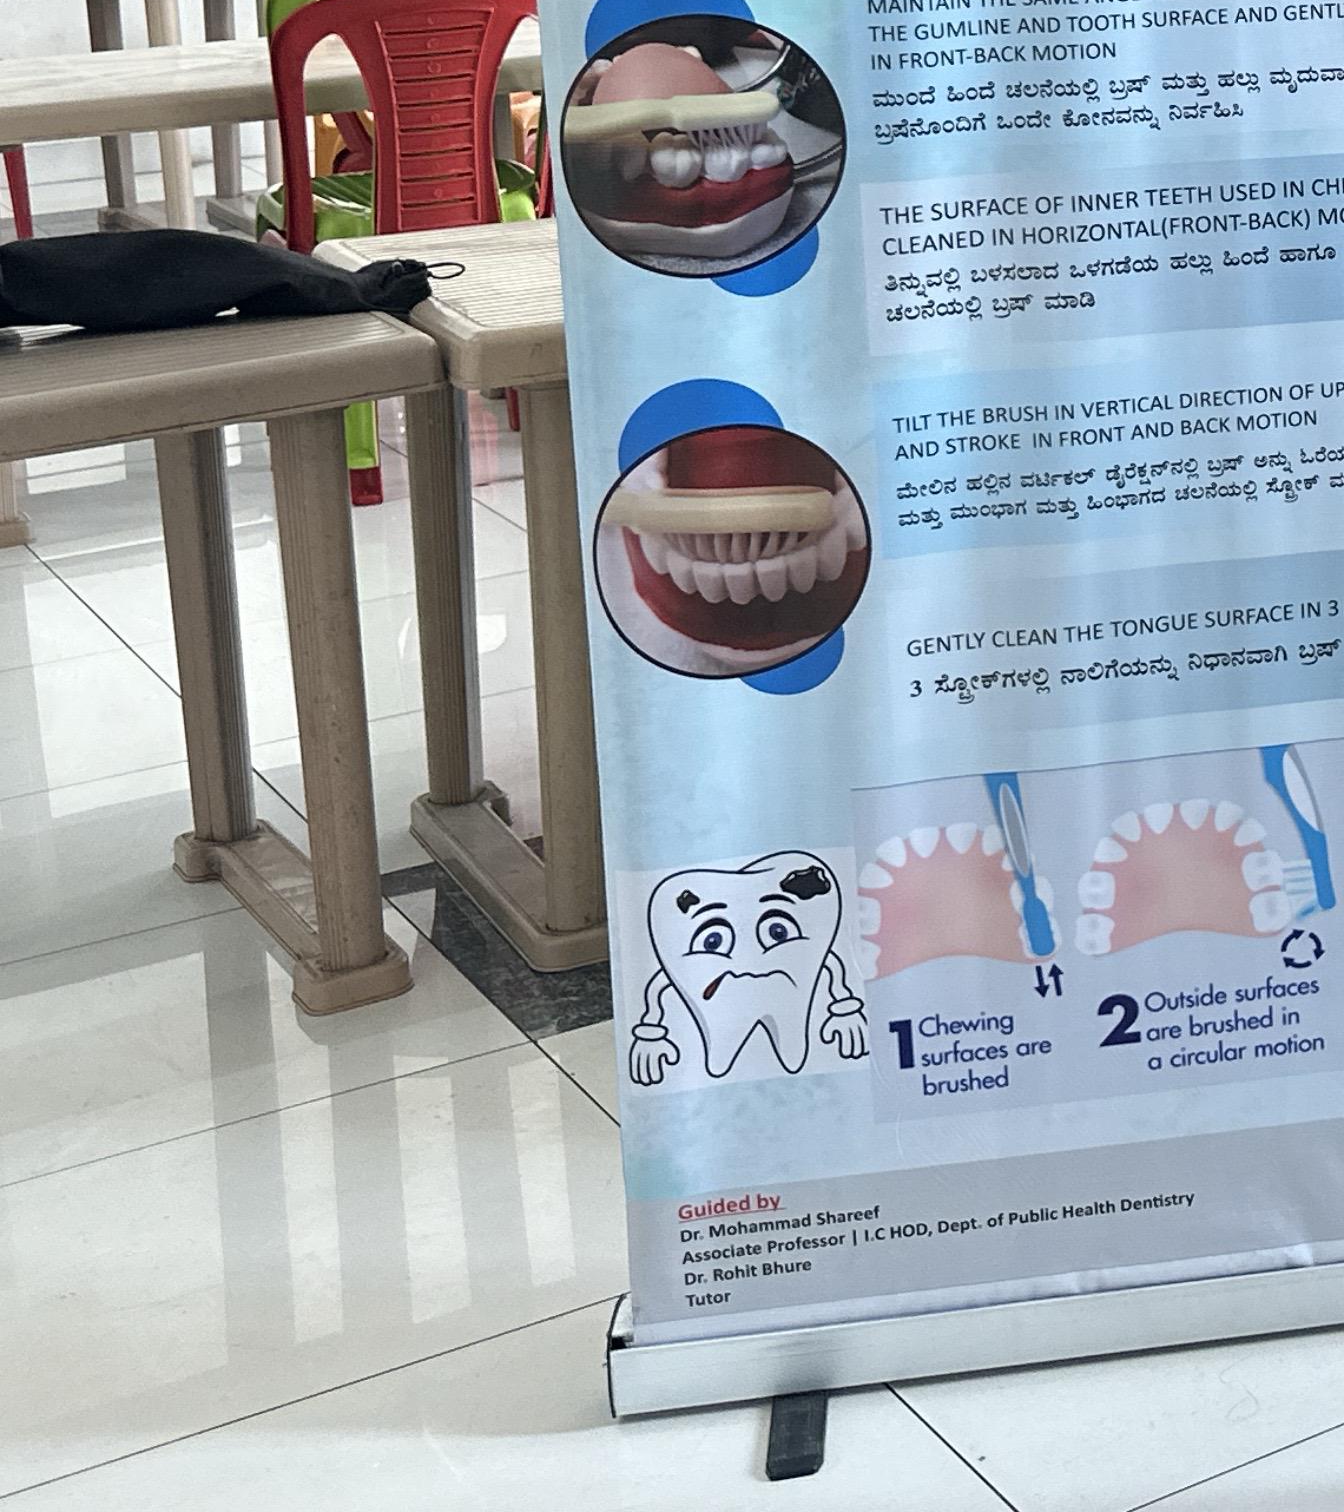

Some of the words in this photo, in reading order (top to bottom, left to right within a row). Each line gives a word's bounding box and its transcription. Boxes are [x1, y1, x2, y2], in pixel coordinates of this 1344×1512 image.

[906, 631, 986, 658] GENTLY
[991, 627, 1058, 649] CLEAN
[1062, 622, 1104, 644] THE
[1109, 611, 1198, 638] TONGUE
[1204, 602, 1294, 629] SURFACE
[1300, 601, 1321, 620] IN
[1327, 598, 1340, 618] 3
[1144, 983, 1227, 1014] Outside
[1235, 975, 1320, 1002] surfaces
[918, 1010, 1015, 1037] Chewing
[1097, 994, 1142, 1048] 2
[1146, 1020, 1182, 1041] are
[1188, 1009, 1273, 1038] brushed
[1281, 1006, 1300, 1027] in
[888, 1019, 915, 1070] 1
[921, 1040, 1009, 1067] surfaces
[1015, 1038, 1053, 1058] are
[1148, 1052, 1163, 1071] a
[1169, 1040, 1245, 1069] circular
[1254, 1033, 1325, 1060] motion
[922, 1064, 1010, 1097] brushed
[678, 1194, 751, 1220] Guided
[756, 1193, 781, 1213] by
[680, 1228, 704, 1244] Dr.
[708, 1212, 812, 1239] Mohammad
[816, 1204, 880, 1227] Shareef
[682, 1243, 763, 1266] Associate
[767, 1233, 846, 1254] Professor
[937, 1217, 982, 1235] Dept.
[986, 1211, 1004, 1229] of
[1008, 1206, 1058, 1226] Public
[1062, 1199, 1116, 1220] Health
[1120, 1192, 1195, 1213] Dentistry
[684, 1271, 708, 1287] Dr.
[712, 1263, 758, 1283] Rohit
[761, 1260, 812, 1277] Bhure
[685, 1291, 732, 1309] Tutor
